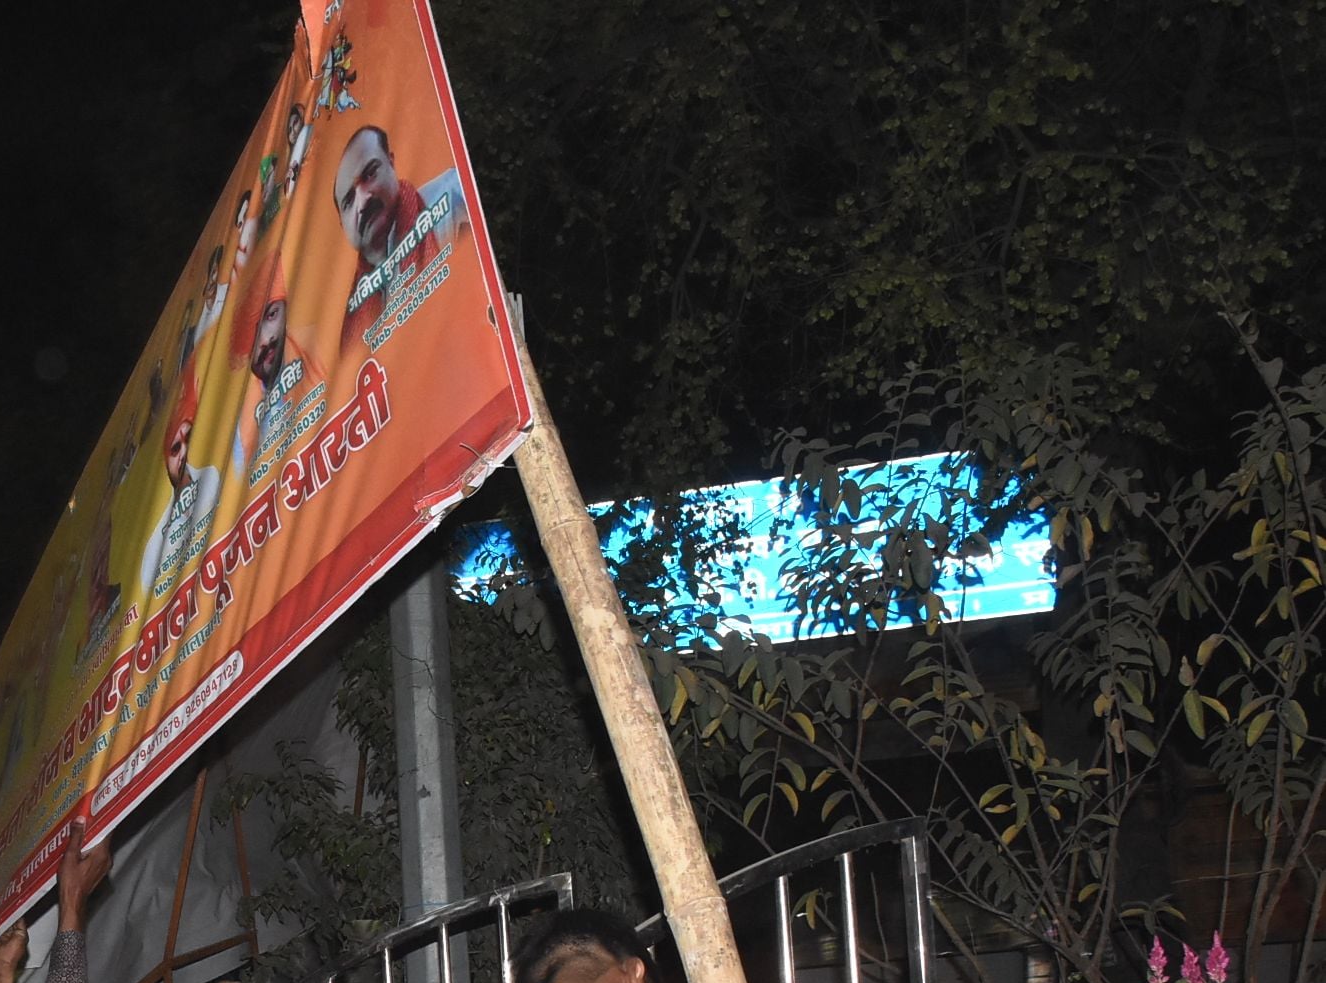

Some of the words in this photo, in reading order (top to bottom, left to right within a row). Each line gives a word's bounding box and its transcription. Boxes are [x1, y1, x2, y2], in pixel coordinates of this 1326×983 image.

[382, 231, 417, 281] कुमार
[416, 192, 450, 241] मिश्रा
[389, 262, 416, 295] संयोजक
[396, 265, 450, 325] 9260947128
[280, 359, 303, 392] सिंह
[78, 645, 136, 745] भारत
[135, 569, 199, 674] माता
[200, 480, 281, 612] पूजन
[280, 358, 391, 511] आरती
[123, 602, 140, 629] का
[185, 659, 239, 717] 9260947128
